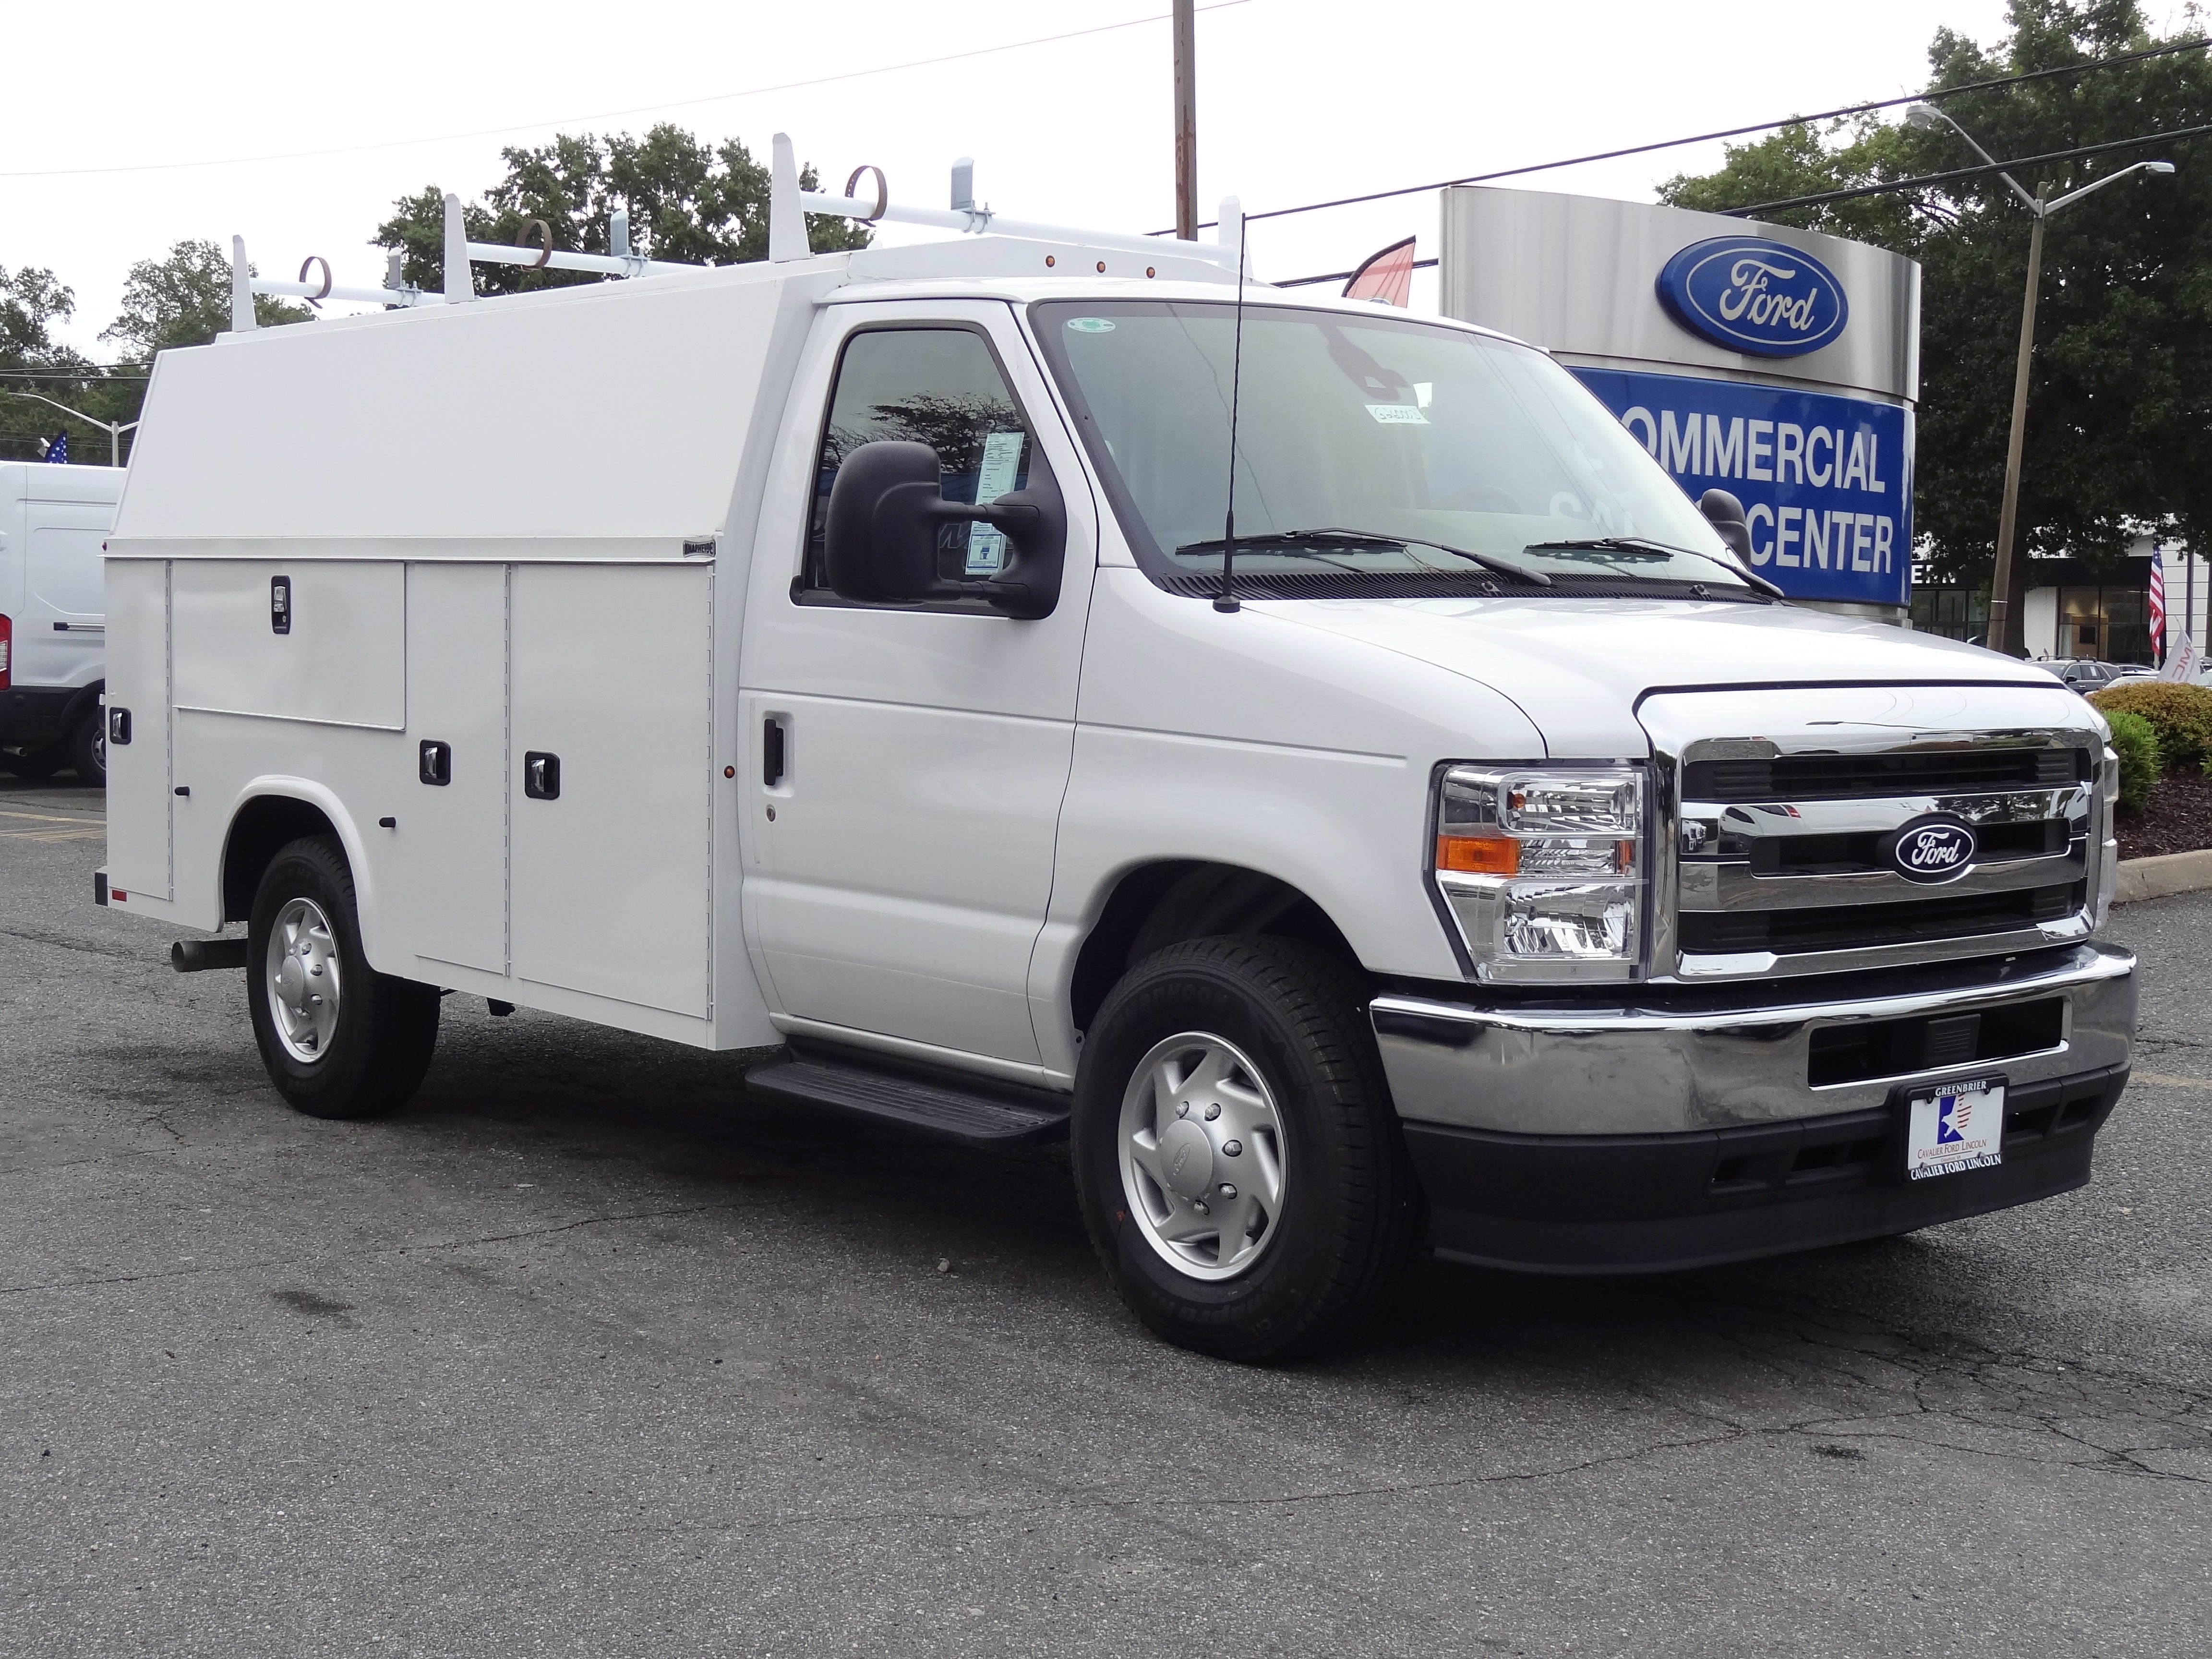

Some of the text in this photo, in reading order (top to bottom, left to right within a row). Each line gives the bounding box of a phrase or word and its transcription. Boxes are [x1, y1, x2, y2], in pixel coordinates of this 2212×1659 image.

[1719, 259, 1816, 331] Ford
[1621, 406, 1886, 493] OMMERCIAL
[685, 541, 714, 555] KNAPHEIDE
[1746, 502, 1893, 574] CENTER
[1911, 831, 1961, 865] Ford
[1935, 1081, 1987, 1097] GREENBRIER
[1917, 1146, 1943, 1159] CAVALIER
[1944, 1143, 1960, 1154] FORD
[1961, 1139, 1987, 1151] LINCOLN
[1911, 1164, 1945, 1180] CAVALIER
[1944, 1162, 1966, 1174] FORD
[1968, 1154, 2002, 1169] LINCOLN
